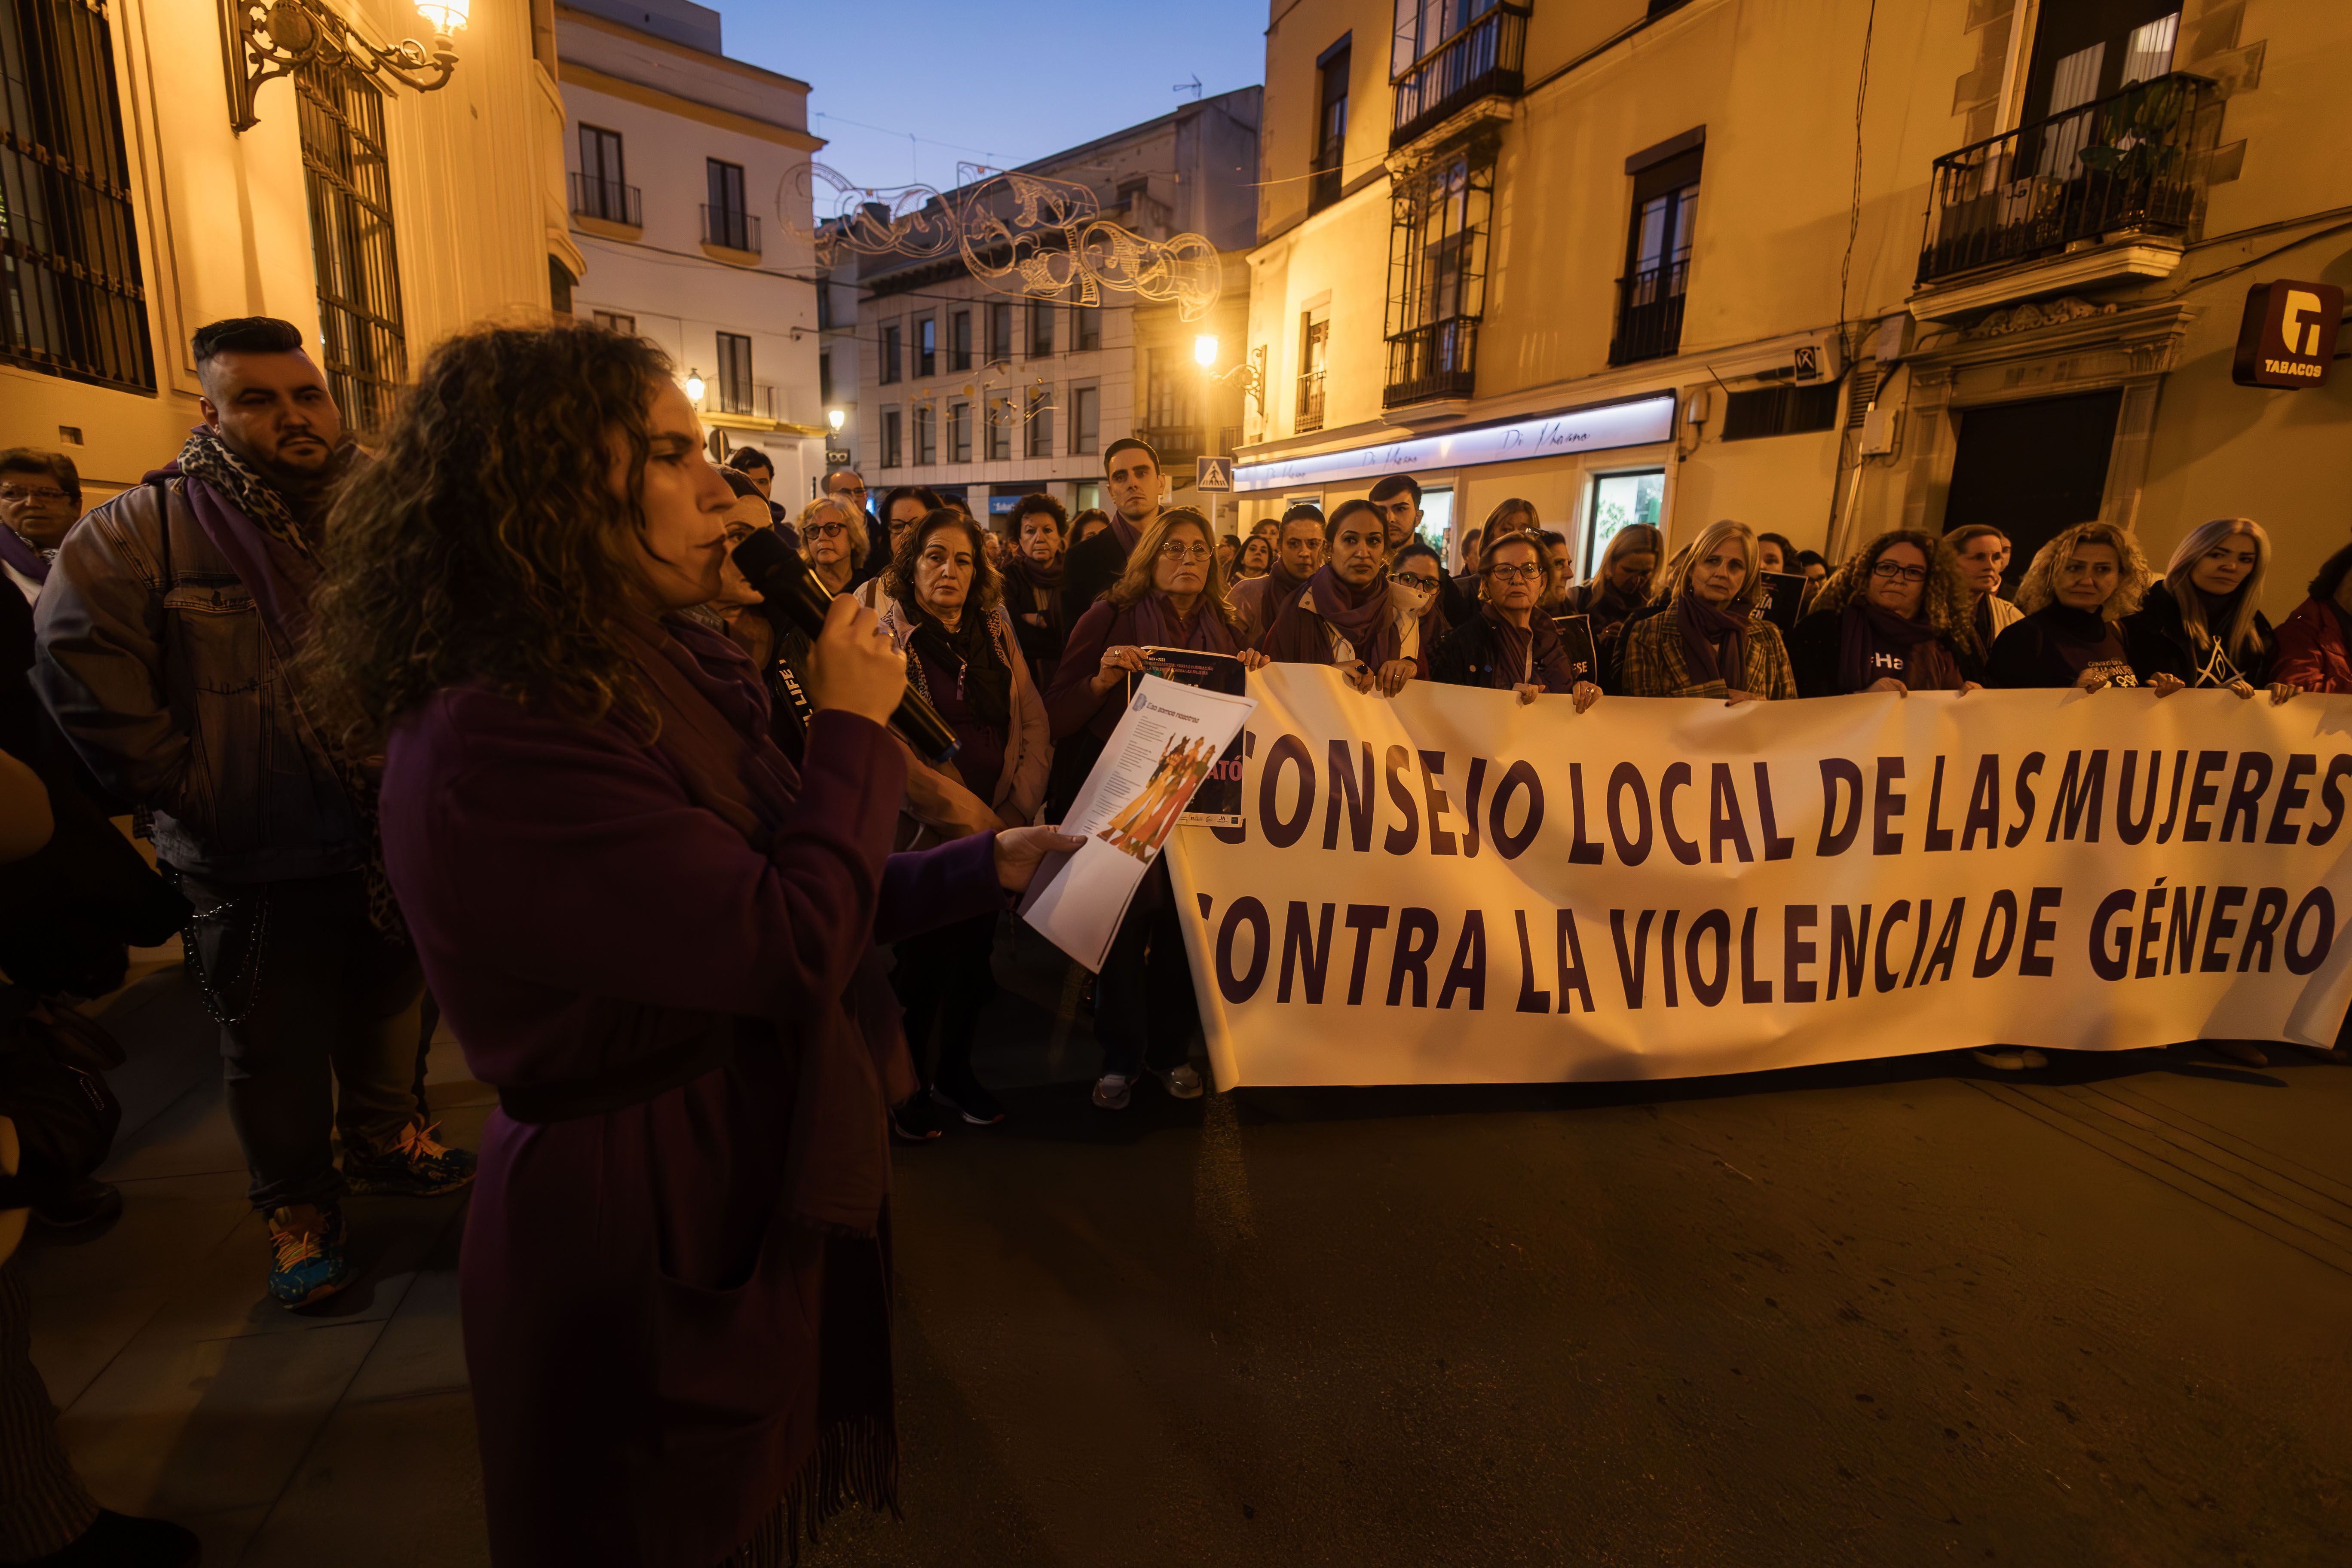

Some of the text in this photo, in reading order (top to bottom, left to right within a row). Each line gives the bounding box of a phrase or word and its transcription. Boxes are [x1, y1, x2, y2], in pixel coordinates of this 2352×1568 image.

[2265, 359, 2322, 377] TABACOS
[779, 669, 807, 706] LIFE
[1567, 761, 1795, 867] LOCAL
[1816, 756, 1906, 857] DE
[1924, 751, 2046, 852] LAS
[2045, 749, 2352, 846] MUJERES
[1196, 876, 2335, 1014] ONTRA LA VIOLENCIA DE GÉNERO
